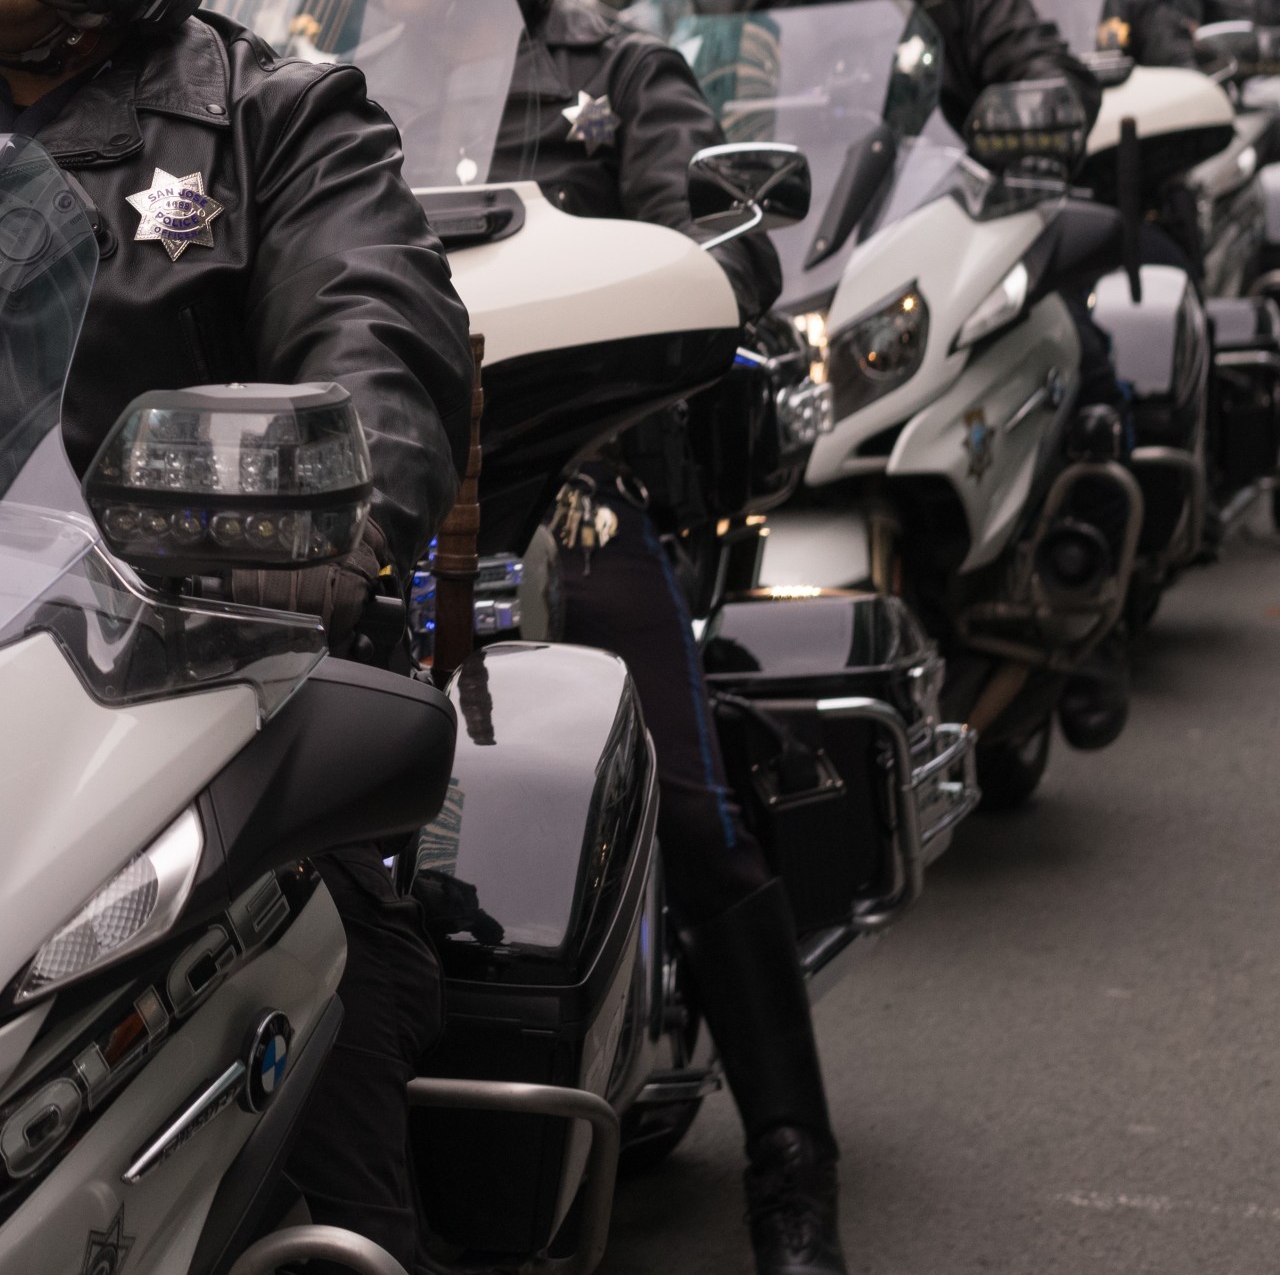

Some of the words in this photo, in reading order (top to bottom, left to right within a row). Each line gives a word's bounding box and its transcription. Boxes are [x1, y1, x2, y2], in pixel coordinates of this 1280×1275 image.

[148, 188, 174, 202] SAN
[178, 189, 208, 208] JOSE
[155, 211, 199, 227] POLICE
[155, 227, 198, 240] OFFICER
